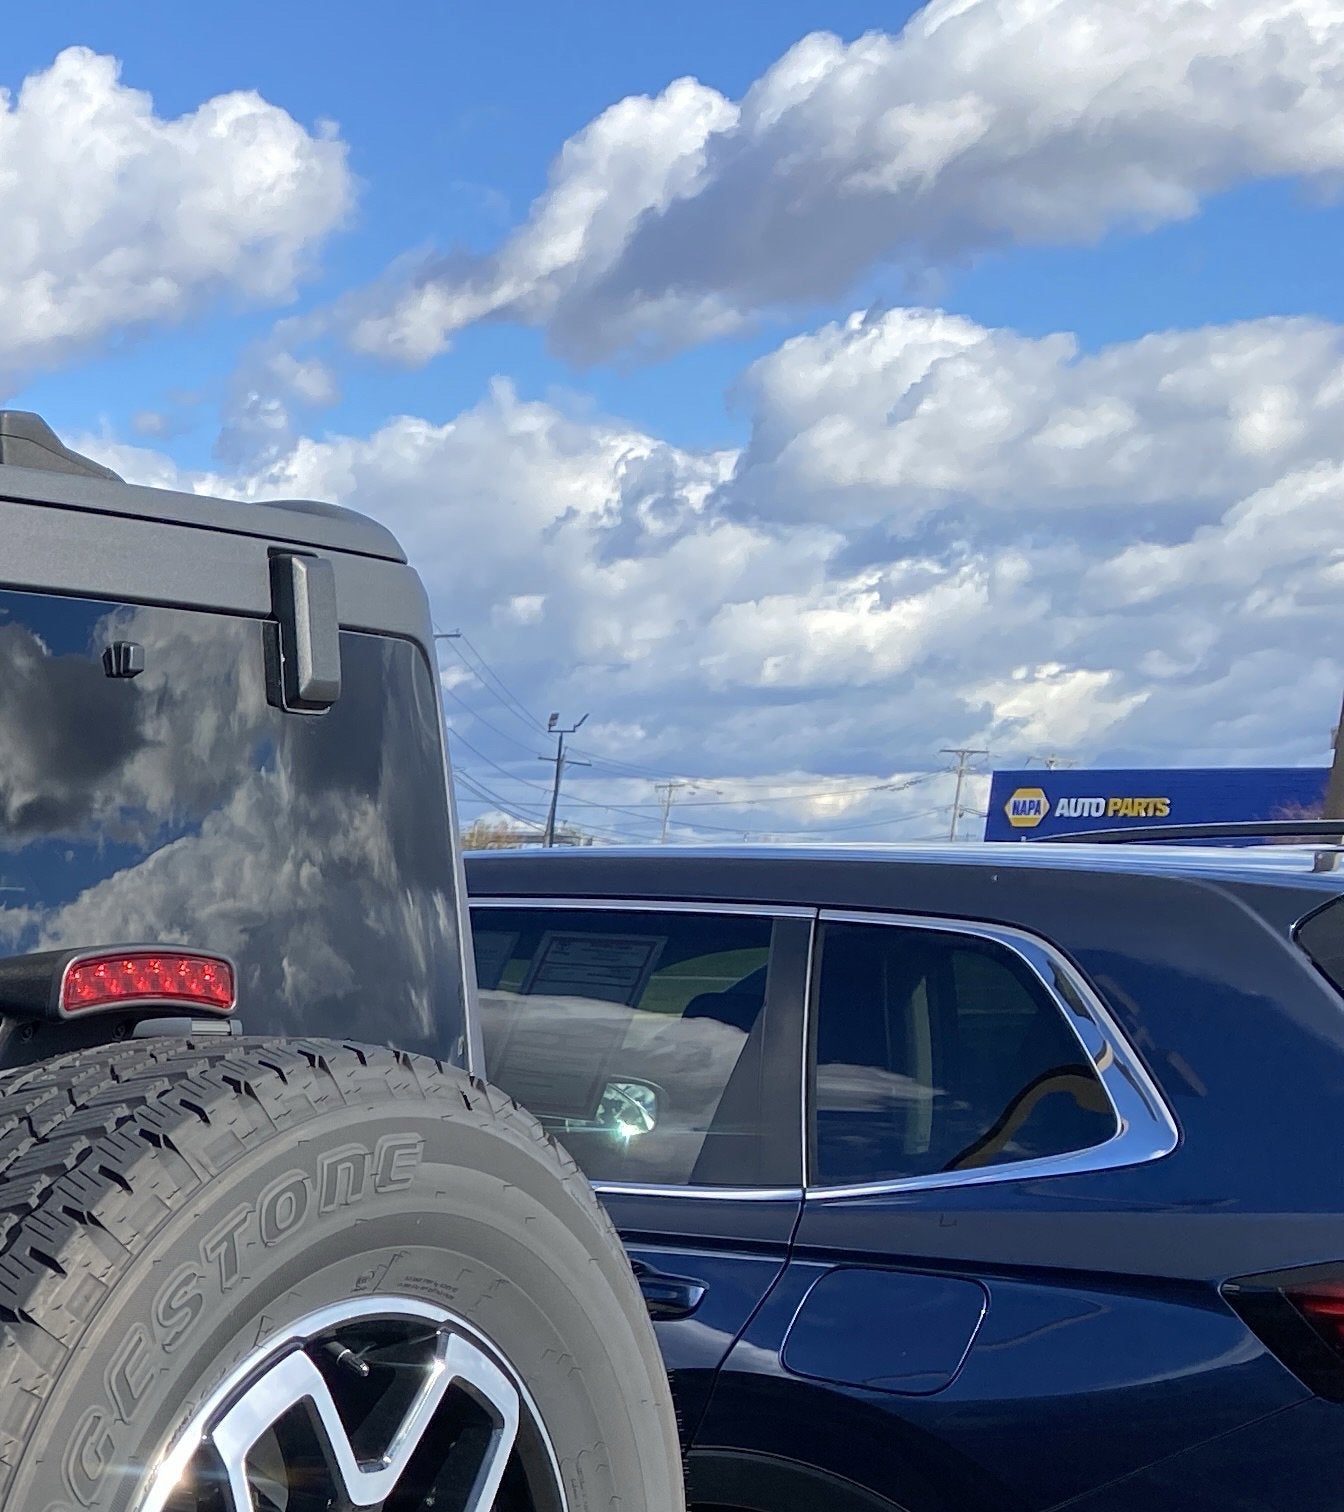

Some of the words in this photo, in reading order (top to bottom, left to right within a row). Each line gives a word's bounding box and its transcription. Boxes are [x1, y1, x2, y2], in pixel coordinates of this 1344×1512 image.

[1012, 799, 1041, 816] NAPA
[1054, 797, 1106, 817] AUTO
[1107, 797, 1171, 817] PARTS
